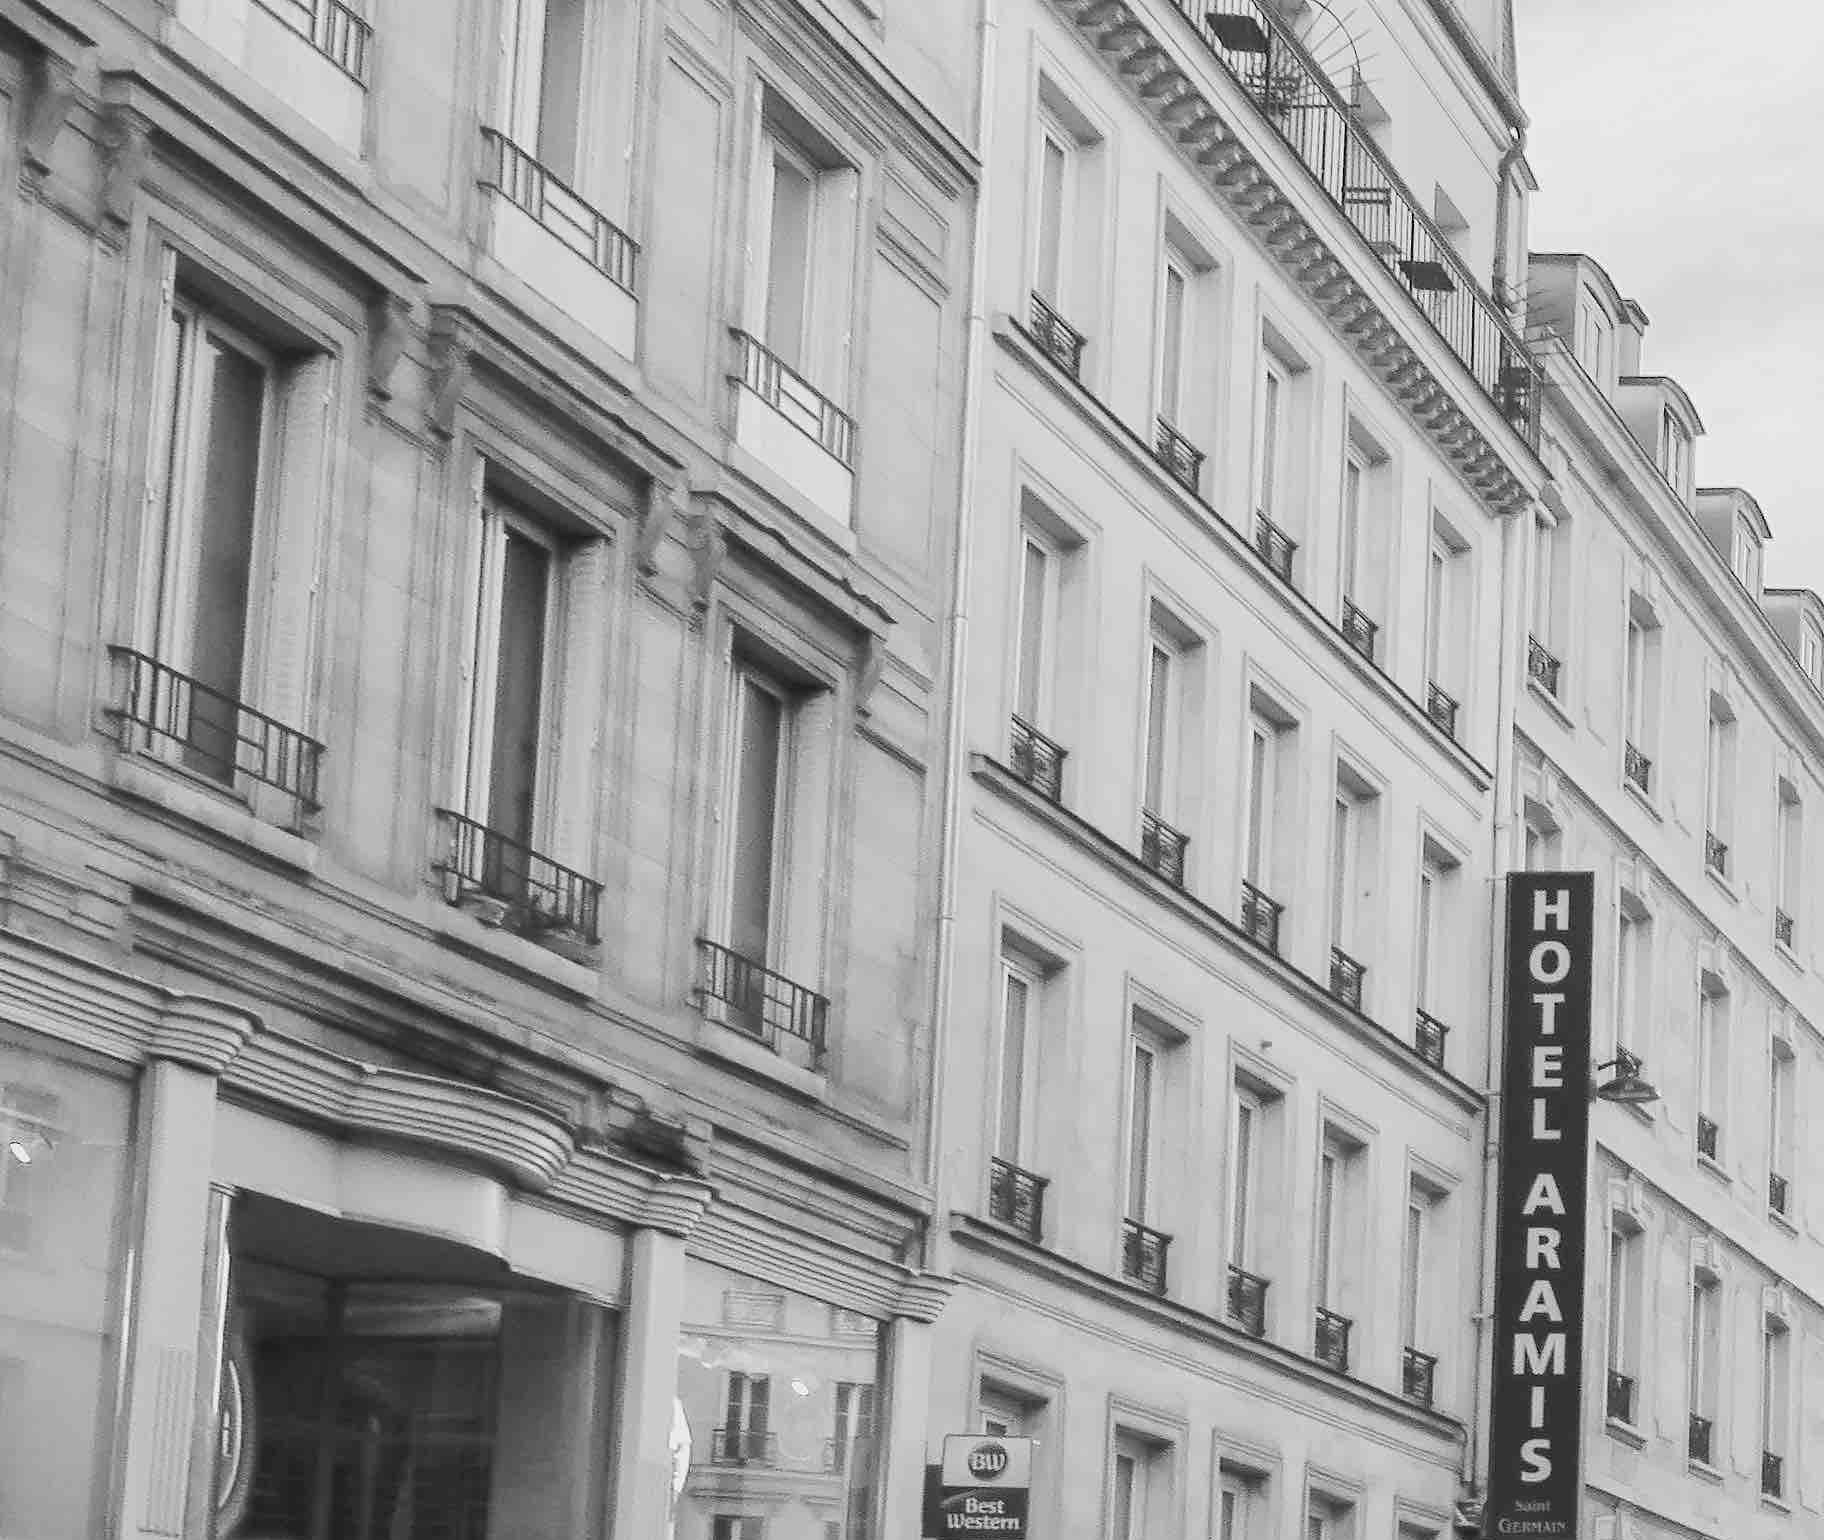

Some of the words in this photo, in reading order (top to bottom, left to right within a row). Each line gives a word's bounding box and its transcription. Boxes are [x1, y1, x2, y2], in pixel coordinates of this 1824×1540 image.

[1529, 889, 1571, 1141] HOTEL
[1513, 1172, 1567, 1483] ARAMIS
[971, 1453, 1006, 1471] BW
[965, 1497, 1006, 1514] Best
[1514, 1499, 1551, 1512] Saint
[947, 1513, 1020, 1530] Western
